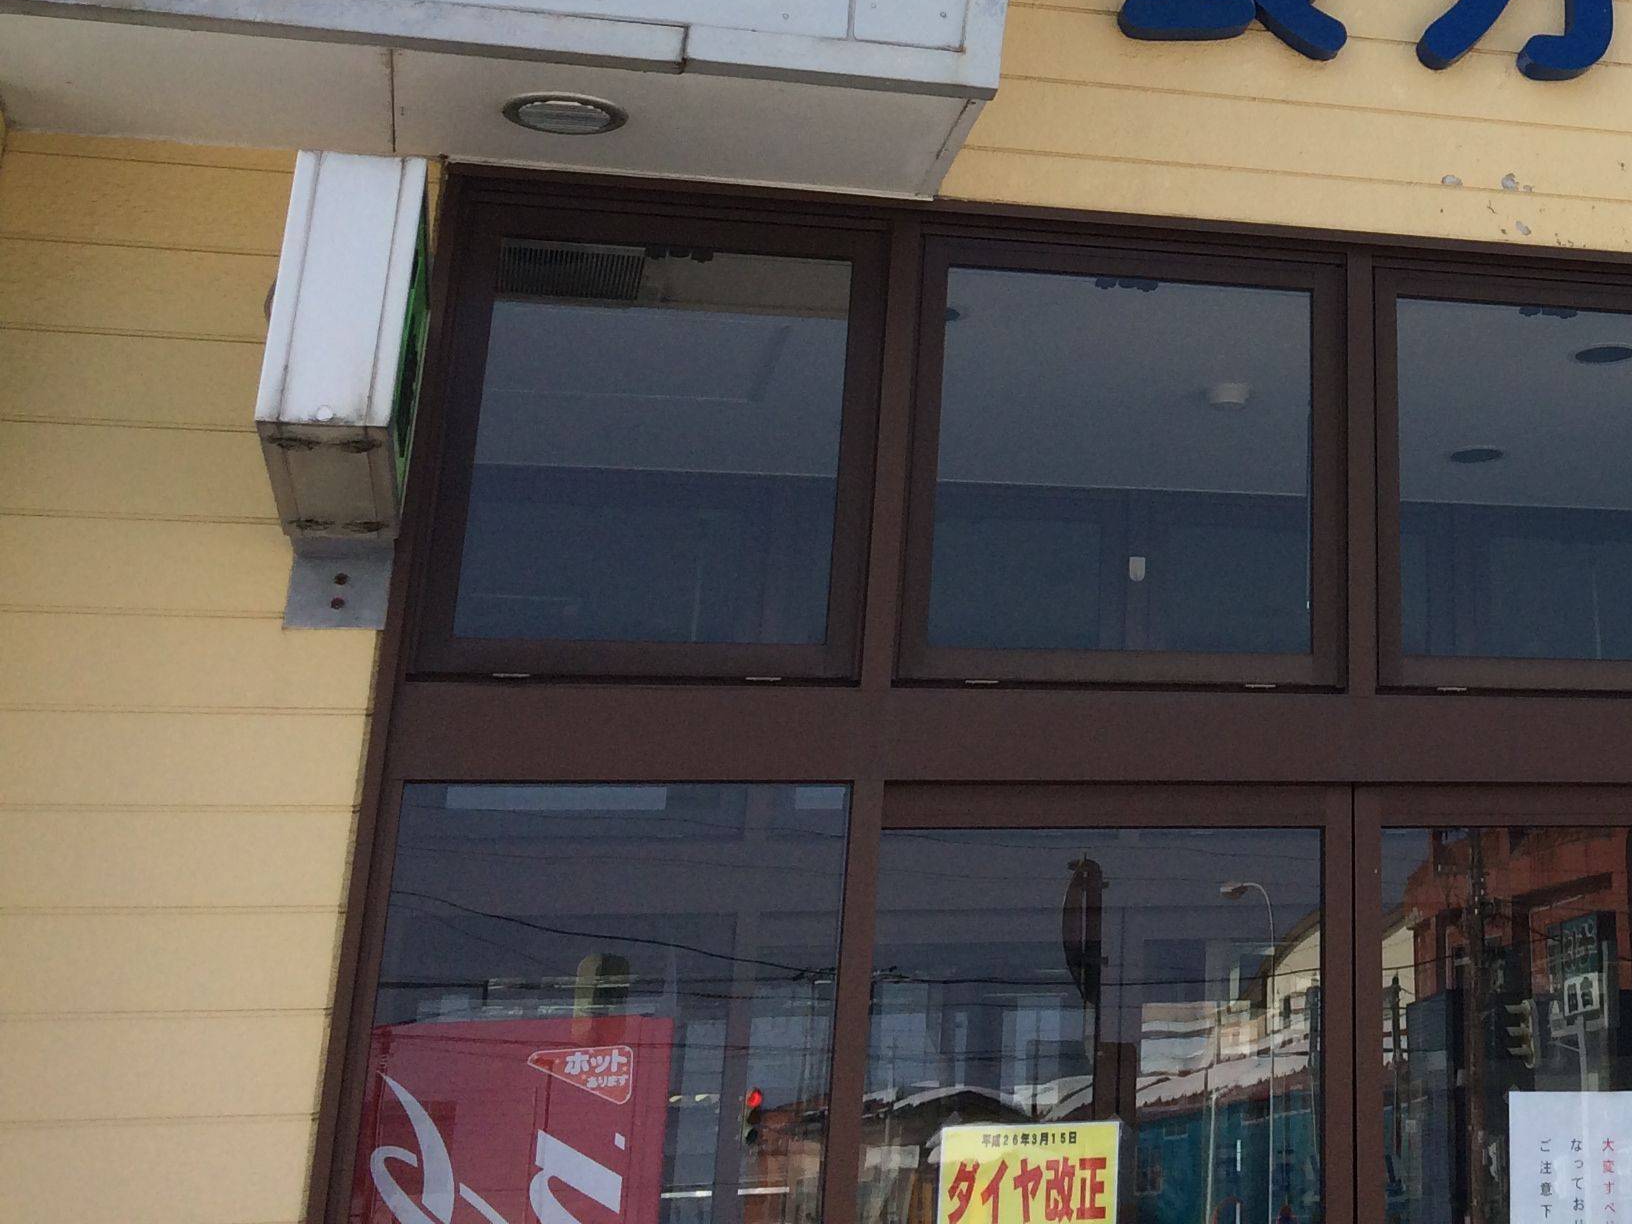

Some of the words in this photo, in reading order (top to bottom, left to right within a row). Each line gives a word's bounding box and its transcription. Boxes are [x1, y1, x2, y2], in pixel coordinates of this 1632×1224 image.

[564, 1049, 628, 1075] ホット
[586, 1075, 629, 1089] あります
[981, 1131, 1078, 1148] 平成26年3月15日
[948, 1156, 1107, 1224] ダイヤ改正
